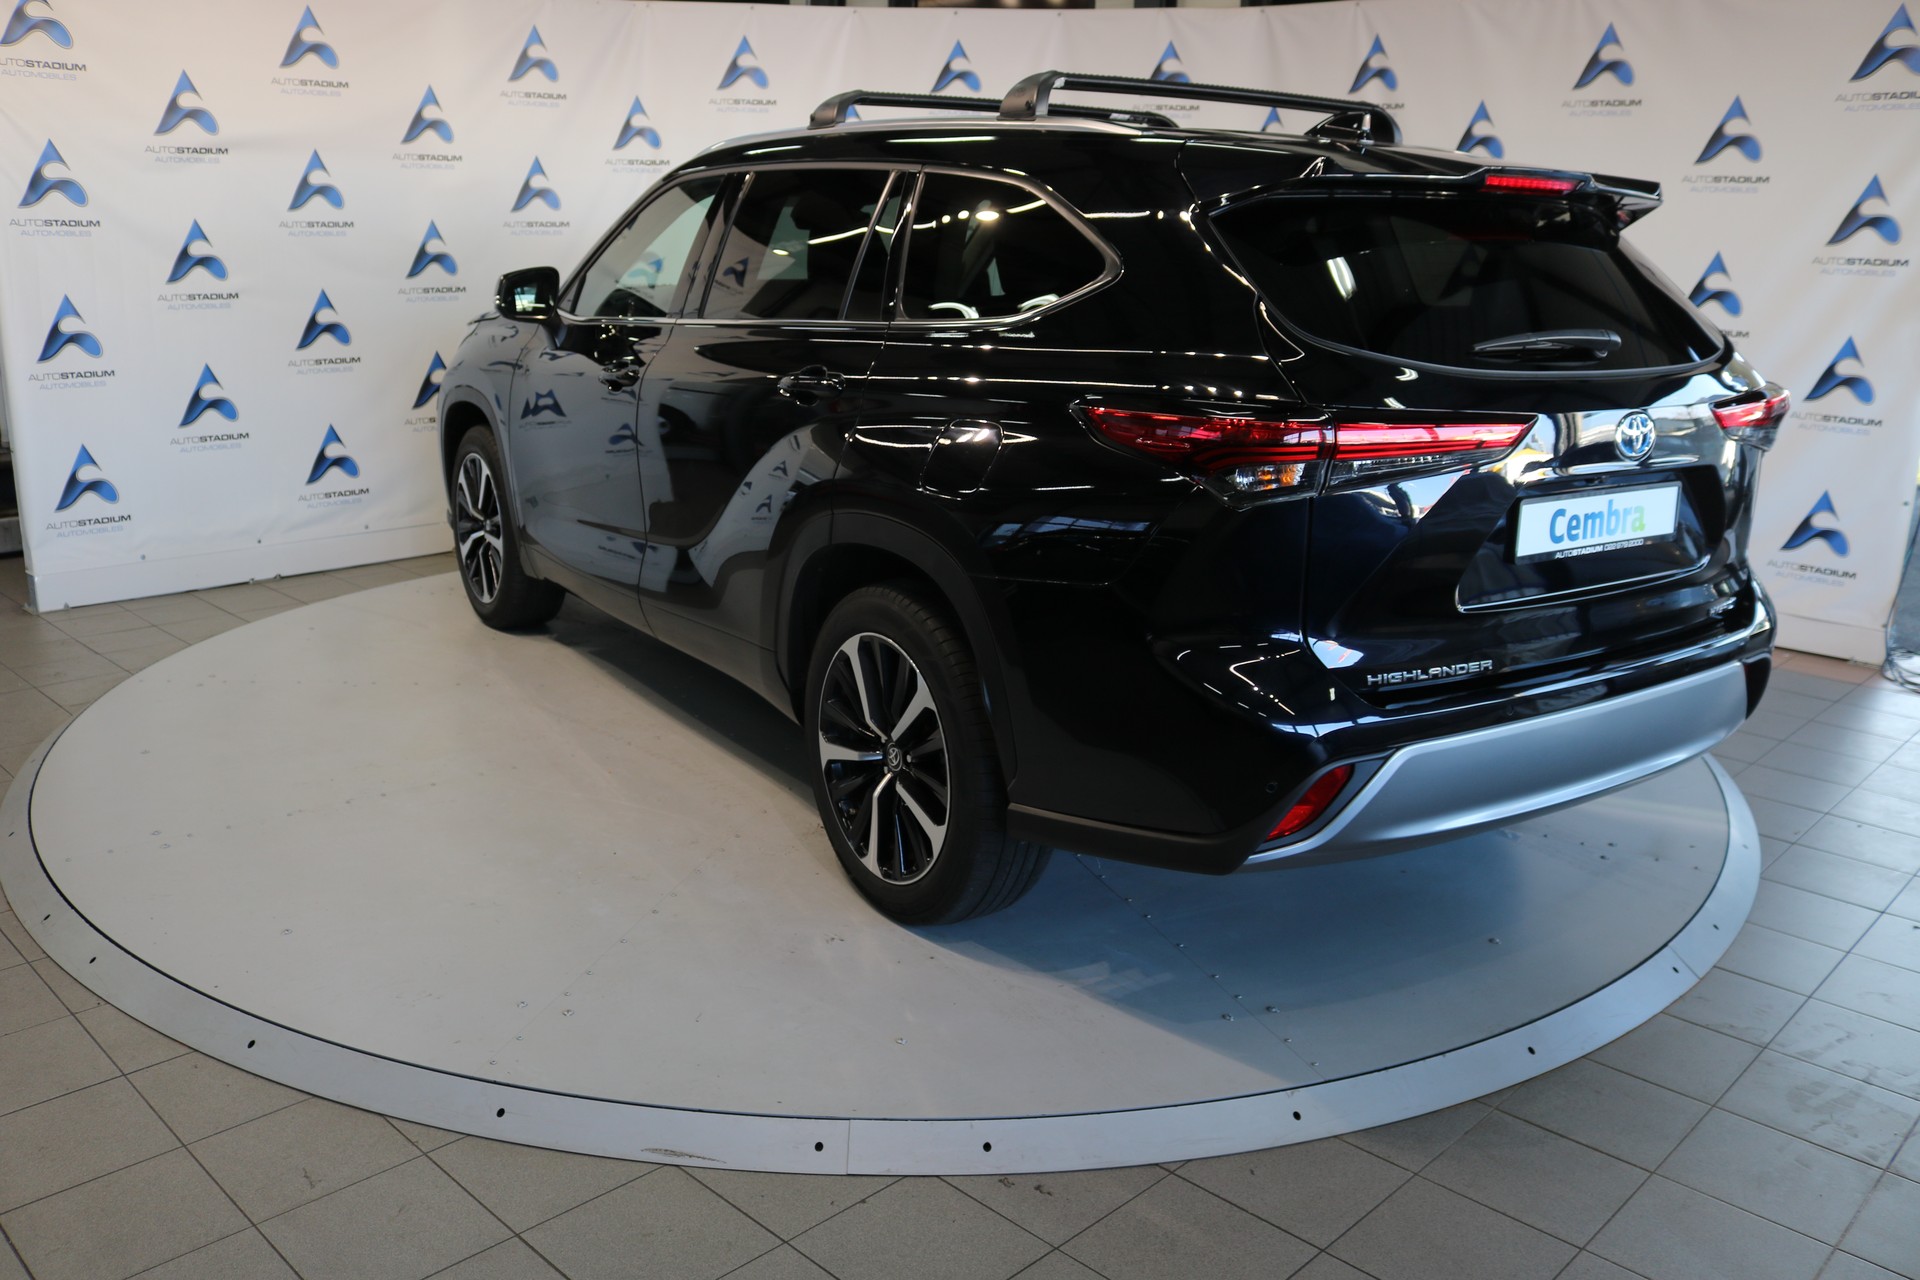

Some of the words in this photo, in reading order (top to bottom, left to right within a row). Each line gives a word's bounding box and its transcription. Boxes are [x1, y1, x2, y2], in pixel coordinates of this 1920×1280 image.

[0, 57, 87, 72] UTOSTADIUM
[1, 69, 77, 81] AUTOMOBILES
[271, 77, 349, 89] AUTOSTADIUM
[280, 87, 341, 97] AUTOMOBILES
[500, 90, 567, 101] AUTOSTADIUM
[1835, 90, 1920, 103] AUTOSTADIU
[709, 97, 777, 107] AUTOSTADIUM
[1562, 98, 1642, 108] AUTOSTADIUM
[144, 145, 229, 155] AUTOSTADIUM
[154, 156, 220, 165] AUTOMOBILES
[392, 153, 462, 163] AUTOSTADIUM
[605, 158, 670, 167] AUTOSTADIUM
[1682, 175, 1771, 184] AUTOSTADIUM
[1690, 185, 1759, 194] AUTOMOBILES
[9, 218, 101, 228] AUTOSTADIUM
[278, 220, 354, 229] AUTOSTADIUM
[503, 220, 570, 229] AUTOSTADIUM
[20, 229, 92, 237] AUTOMOBILES
[1812, 256, 1909, 268] AUTOSTADIUM
[1820, 267, 1896, 277] AUTOMOBILES
[398, 286, 466, 296] AUTOSTADIUM
[157, 292, 240, 302] AUTOSTADIUM
[167, 302, 231, 310] AUTOMOBILES
[288, 357, 361, 367] AUTOSTADIUM
[28, 369, 115, 382] AUTOSTADIUM
[39, 380, 107, 390] AUTOMOBILES
[1790, 410, 1883, 427] AUTOSTADIUM
[170, 432, 250, 446] AUTOSTADIUM
[298, 488, 370, 503] AUTOSTADIUM
[46, 514, 132, 531] AUTOSTADIUM
[1549, 499, 1645, 544] Cembra
[56, 525, 124, 538] AUTOMOBILES
[1555, 545, 1603, 559] AUTOSTADIUM
[1767, 558, 1857, 580] AUTOSTADIUM
[1367, 659, 1493, 686] HIGHLANDER
